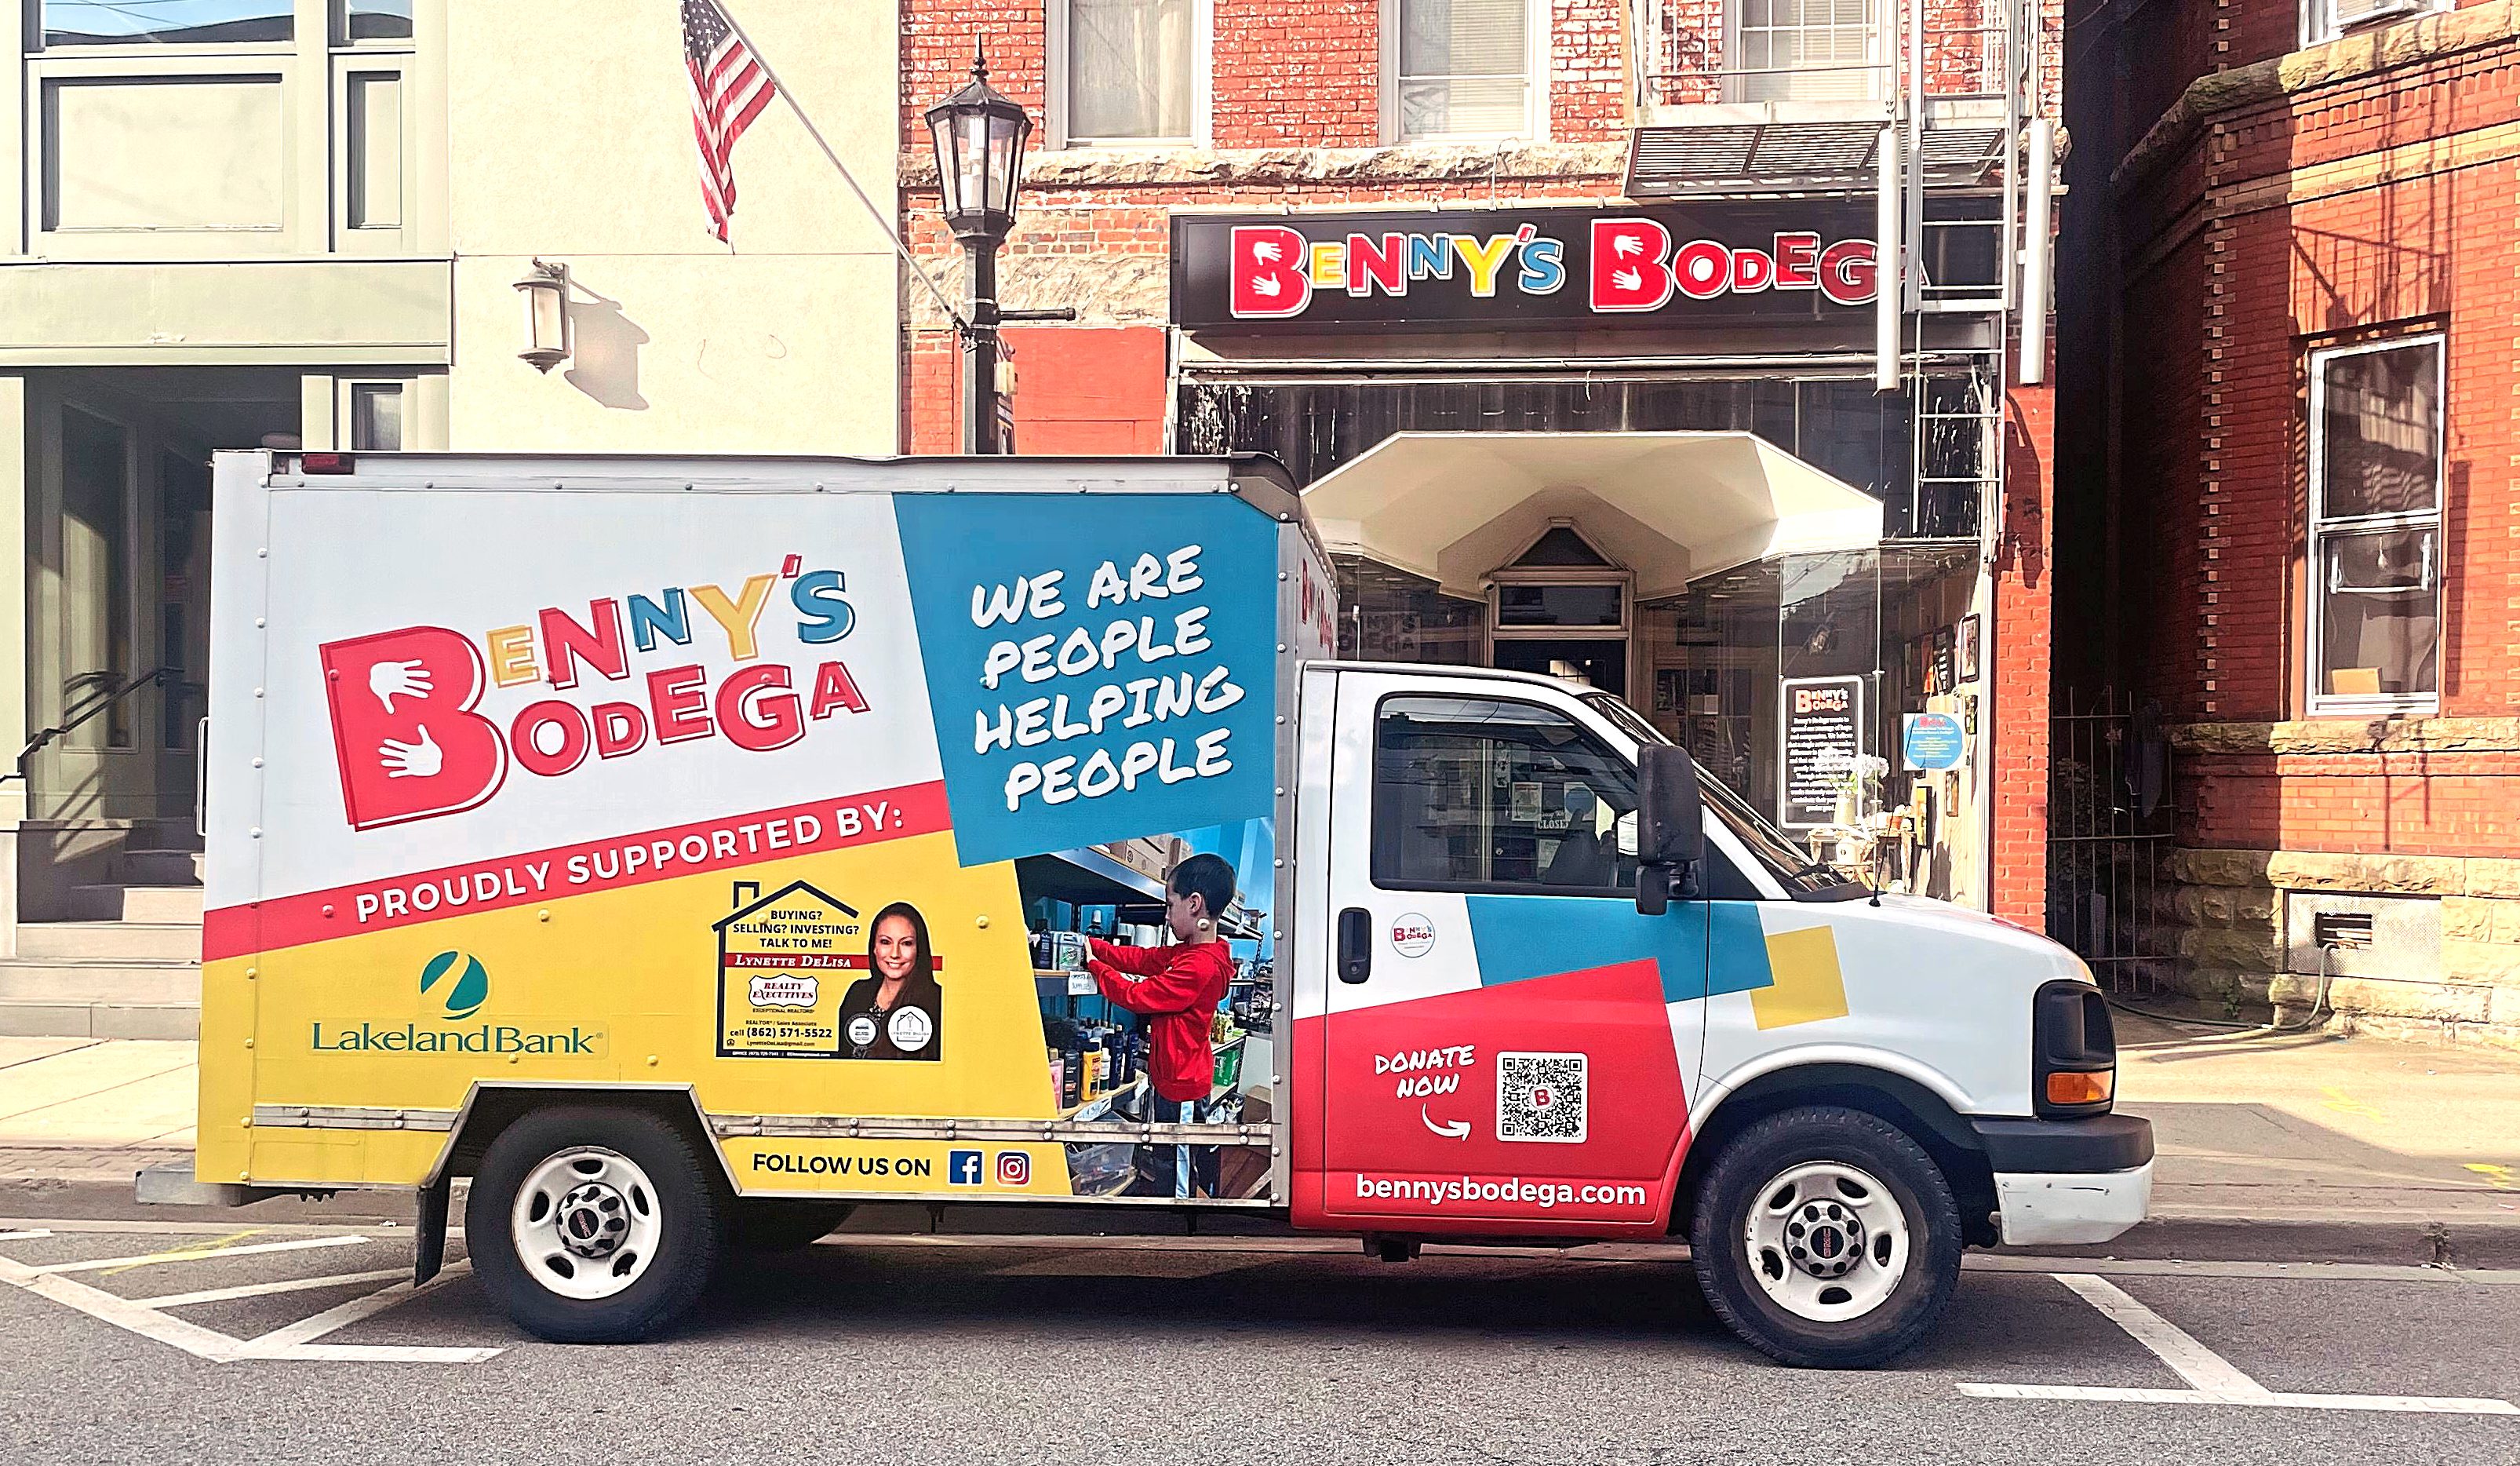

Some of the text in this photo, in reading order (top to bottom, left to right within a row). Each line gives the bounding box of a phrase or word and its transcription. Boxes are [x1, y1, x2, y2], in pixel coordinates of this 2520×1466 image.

[1231, 223, 1565, 318] BENNY'S
[971, 544, 1204, 629] WE ARE
[985, 606, 1212, 690] PEOPLE
[319, 554, 856, 832] BENNY'S
[974, 666, 1246, 755] HELPING
[1005, 728, 1233, 812] PEOPLE
[355, 800, 903, 924] PROUDLY SUPPORTED BY:
[770, 910, 823, 921] BUYING?
[733, 924, 860, 935] SELLING? INVESTING?
[1393, 924, 1433, 942] BNNY'S
[759, 938, 832, 948] TALK TO ME!
[734, 954, 796, 966] LYNETTE
[752, 990, 814, 1001] EXECUTIVES
[747, 1027, 777, 1038] (862)
[780, 1027, 832, 1038] 571-5522
[1375, 1045, 1476, 1075] DONATE
[1396, 1074, 1460, 1099] NOW
[1534, 1089, 1550, 1106] B
[752, 1153, 930, 1176] FOLLOW US ON
[1356, 1174, 1646, 1209] bennysbodega.com
